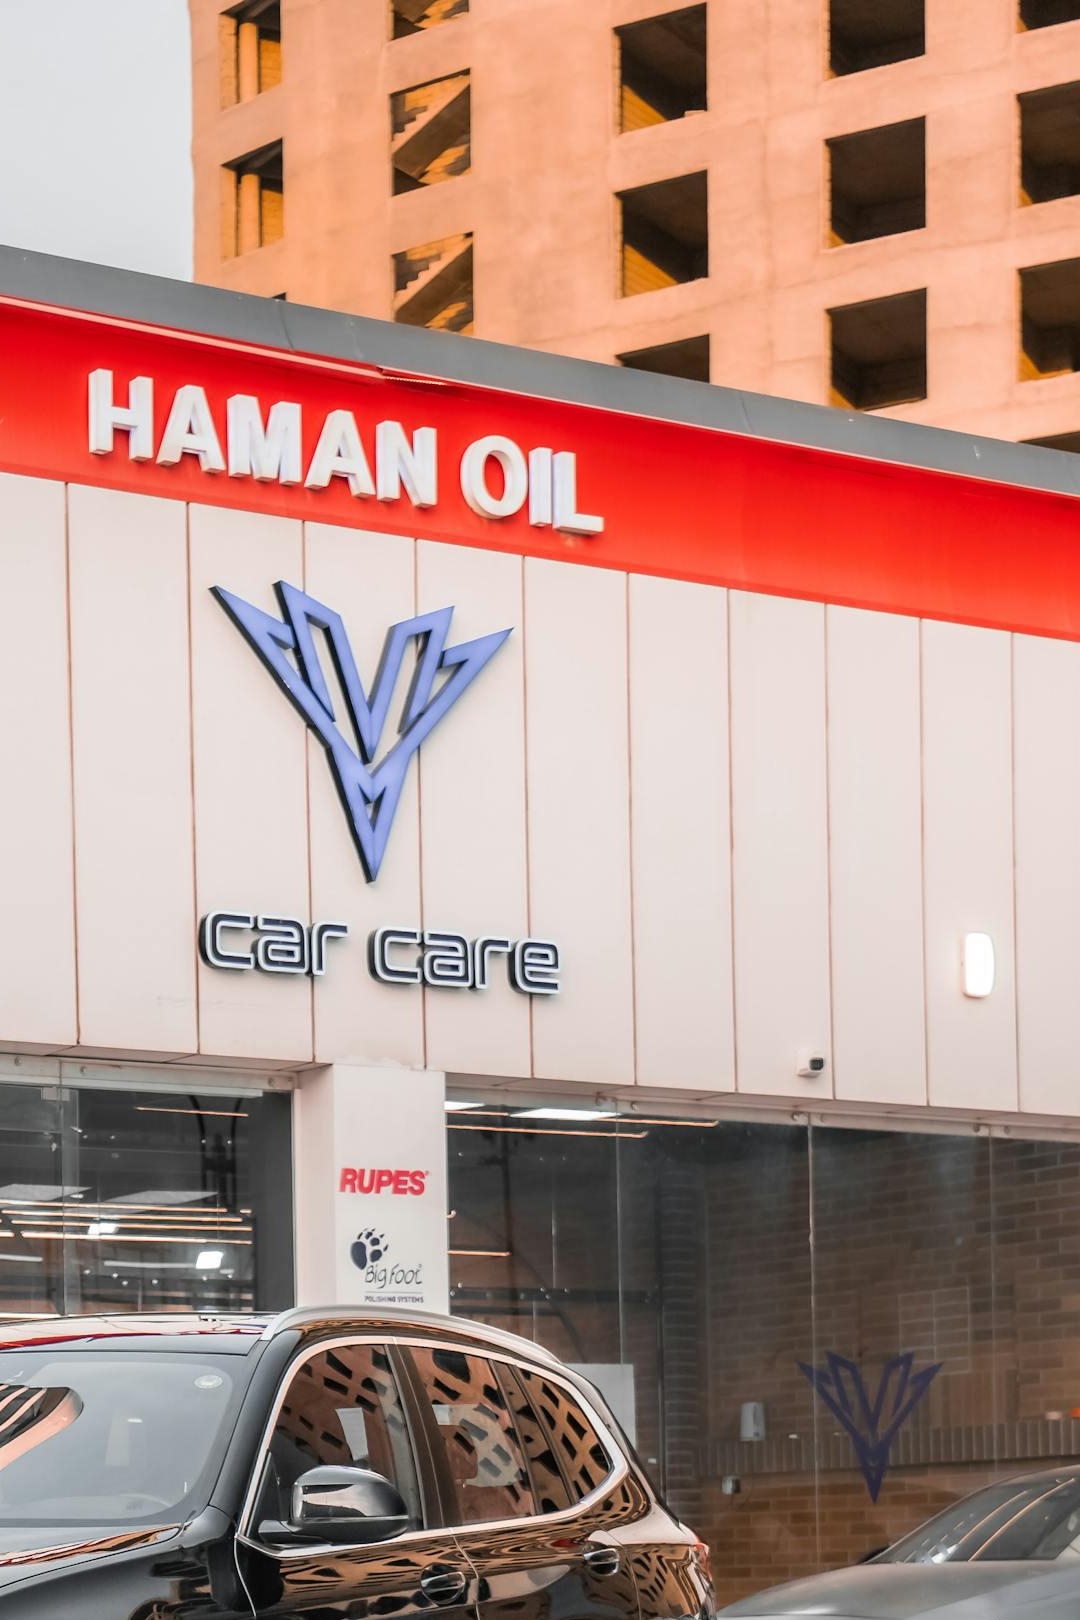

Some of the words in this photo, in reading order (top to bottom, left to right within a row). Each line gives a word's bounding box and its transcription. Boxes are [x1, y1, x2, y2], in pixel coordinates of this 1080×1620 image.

[88, 367, 437, 508] HAMAN
[459, 434, 604, 536] OIL
[199, 911, 348, 977] car
[367, 925, 561, 995] care
[339, 1167, 425, 1196] RUPES
